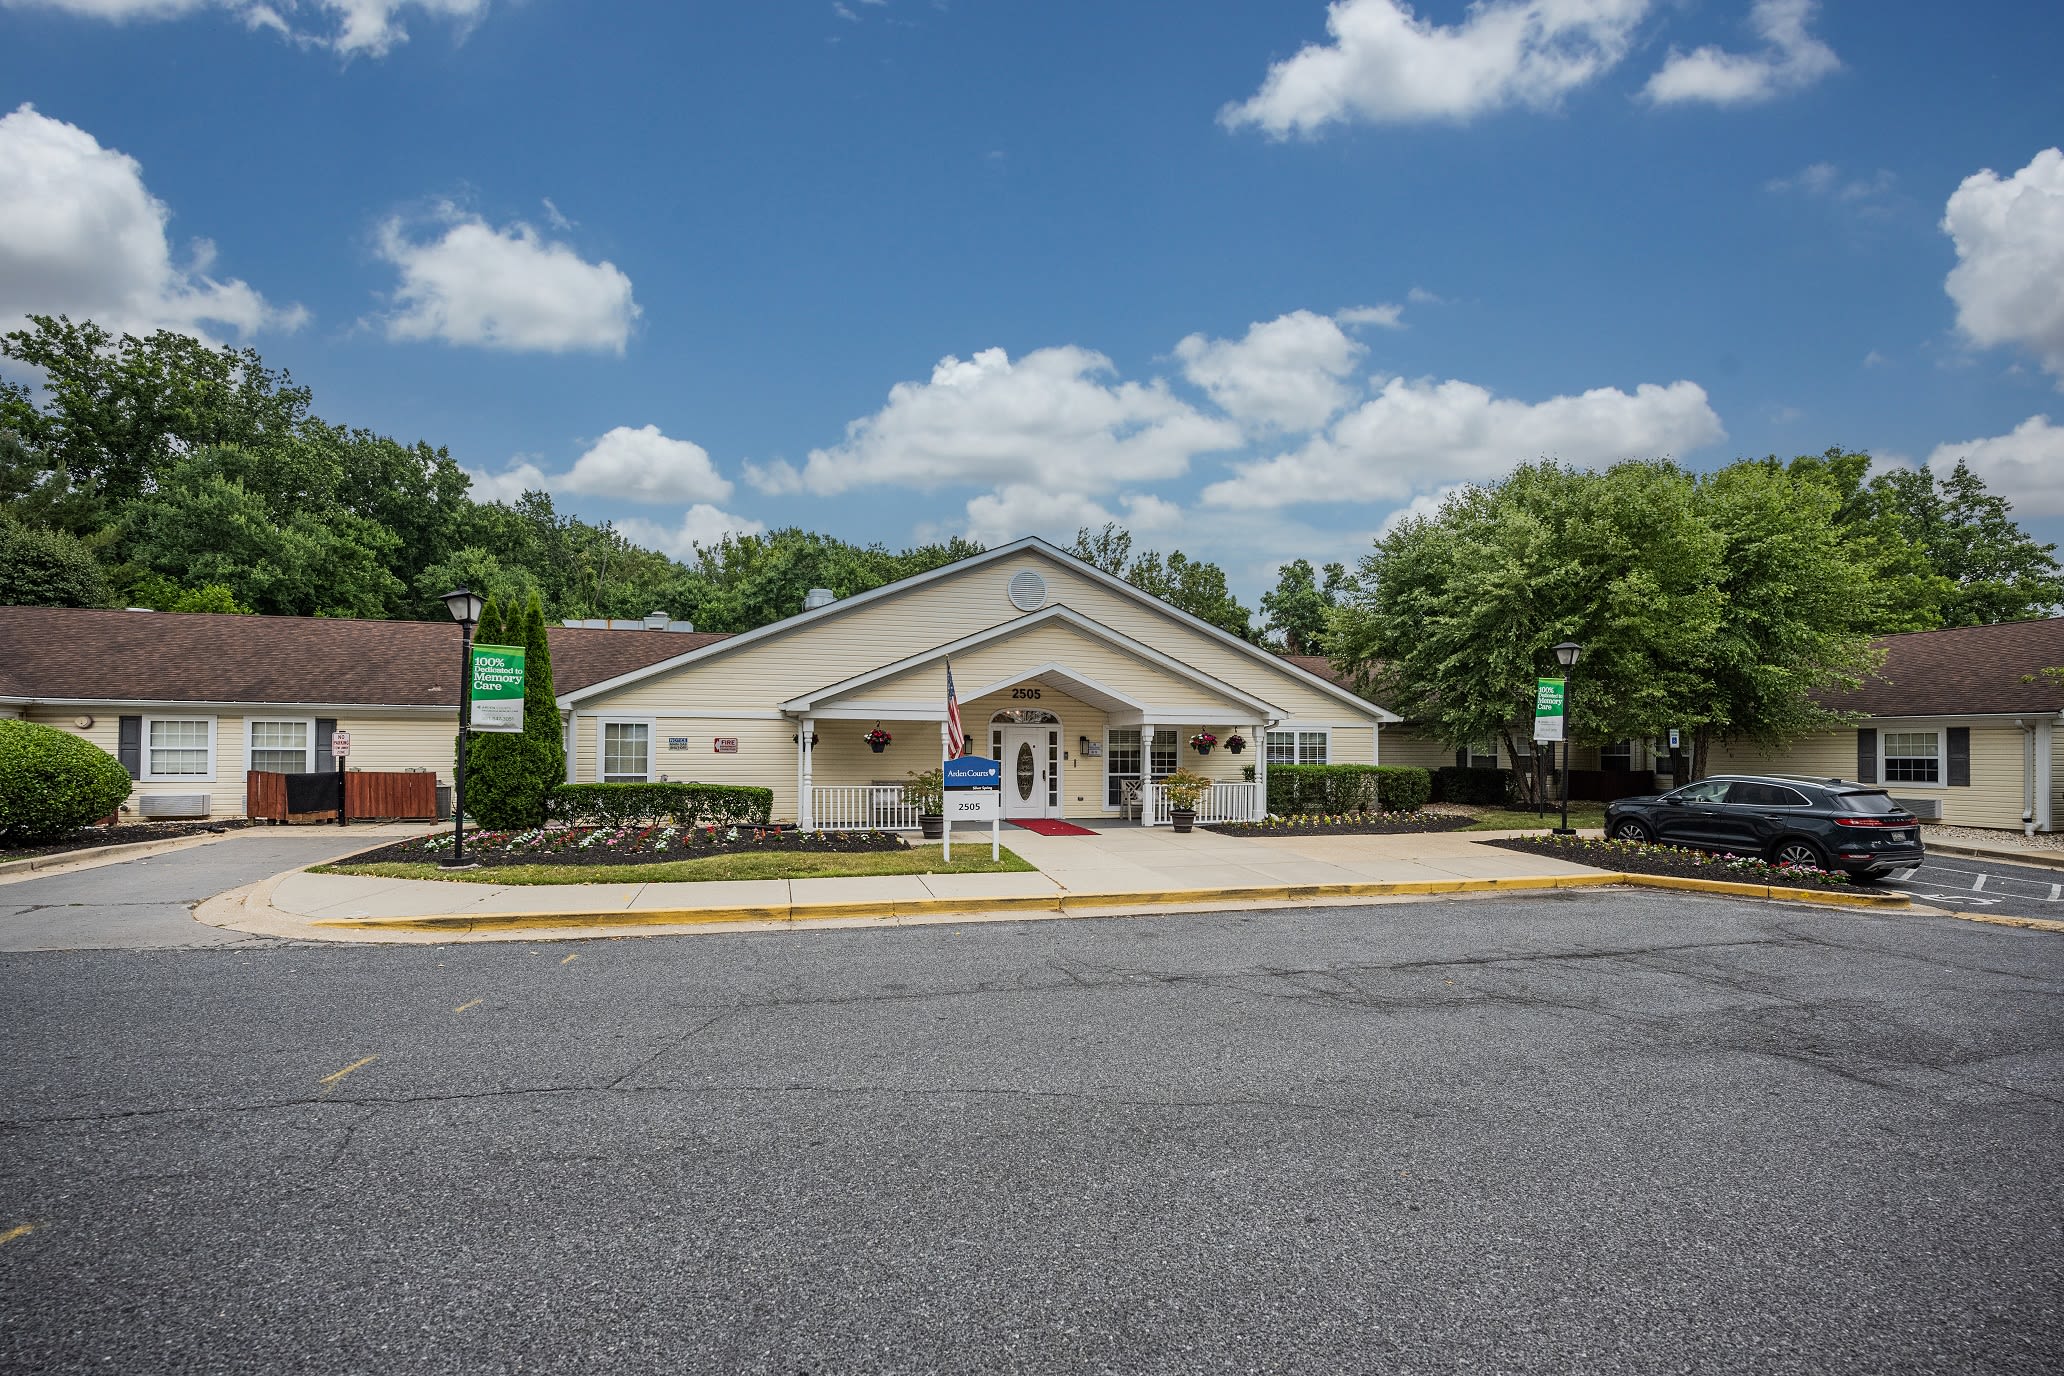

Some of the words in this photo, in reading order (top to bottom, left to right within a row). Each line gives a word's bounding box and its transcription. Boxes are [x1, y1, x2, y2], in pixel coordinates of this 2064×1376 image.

[474, 657, 505, 667] 100%
[474, 666, 513, 674] Dedicated
[474, 672, 523, 685] Memory
[473, 681, 502, 691] Care
[1012, 689, 1041, 699] 2505
[1538, 697, 1563, 706] Memory
[947, 769, 967, 777] Arden
[967, 769, 989, 777] Courts
[958, 803, 981, 811] 2505
